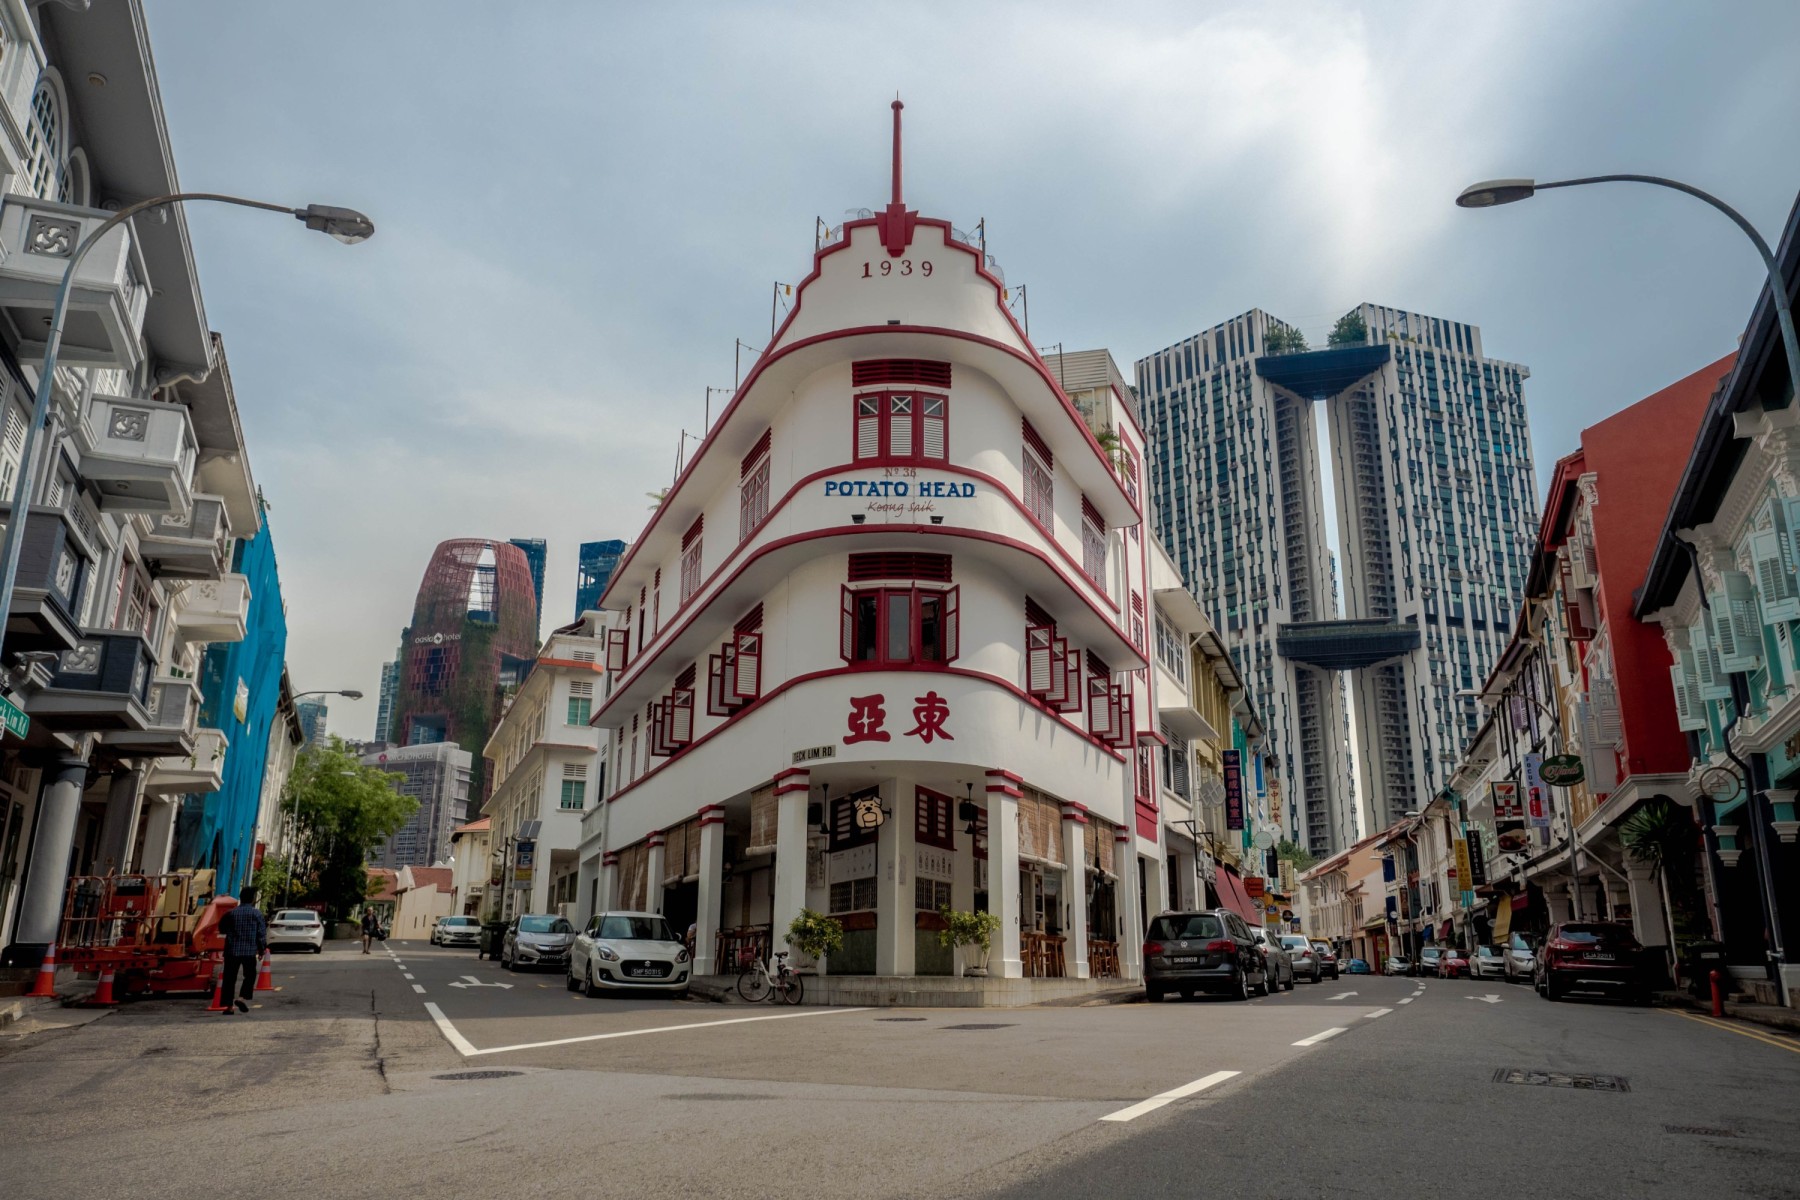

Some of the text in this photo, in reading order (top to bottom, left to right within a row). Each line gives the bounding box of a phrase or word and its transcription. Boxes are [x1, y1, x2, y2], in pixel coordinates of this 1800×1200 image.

[861, 259, 933, 279] 1939
[903, 467, 917, 477] 36
[825, 481, 976, 498] POTATO HEAD
[867, 501, 904, 518] Keong
[443, 632, 462, 641] hotel
[793, 746, 832, 762] TECK LIM RD
[1525, 756, 1534, 787] FOCUS
